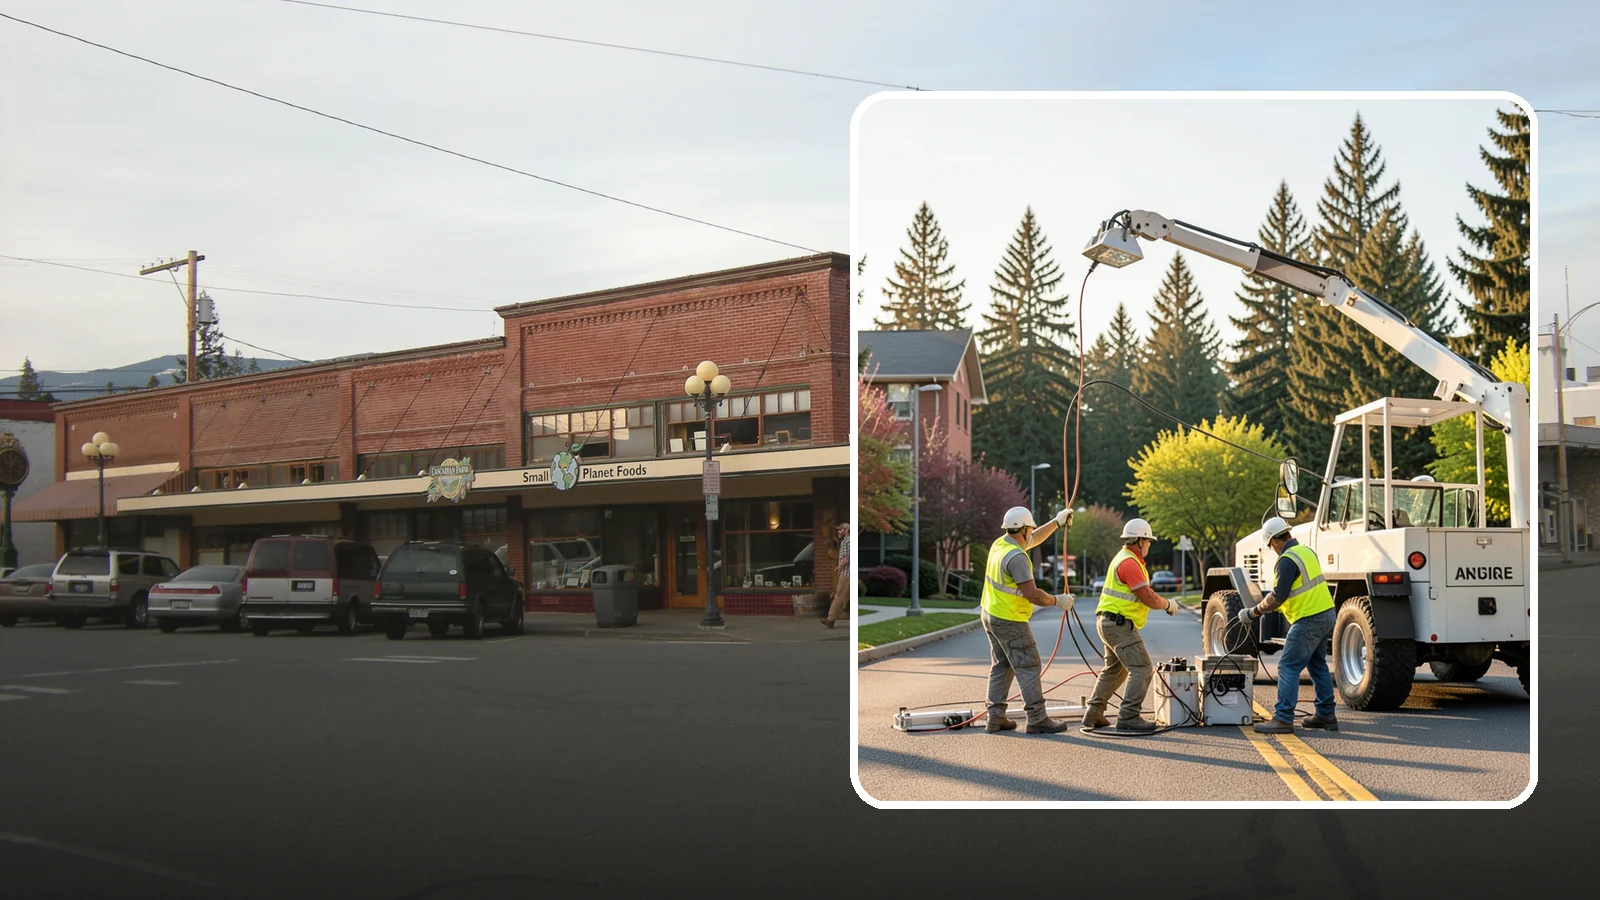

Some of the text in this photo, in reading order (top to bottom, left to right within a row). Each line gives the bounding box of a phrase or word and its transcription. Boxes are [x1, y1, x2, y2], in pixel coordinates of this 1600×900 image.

[523, 464, 647, 483] Small Planet Foods
